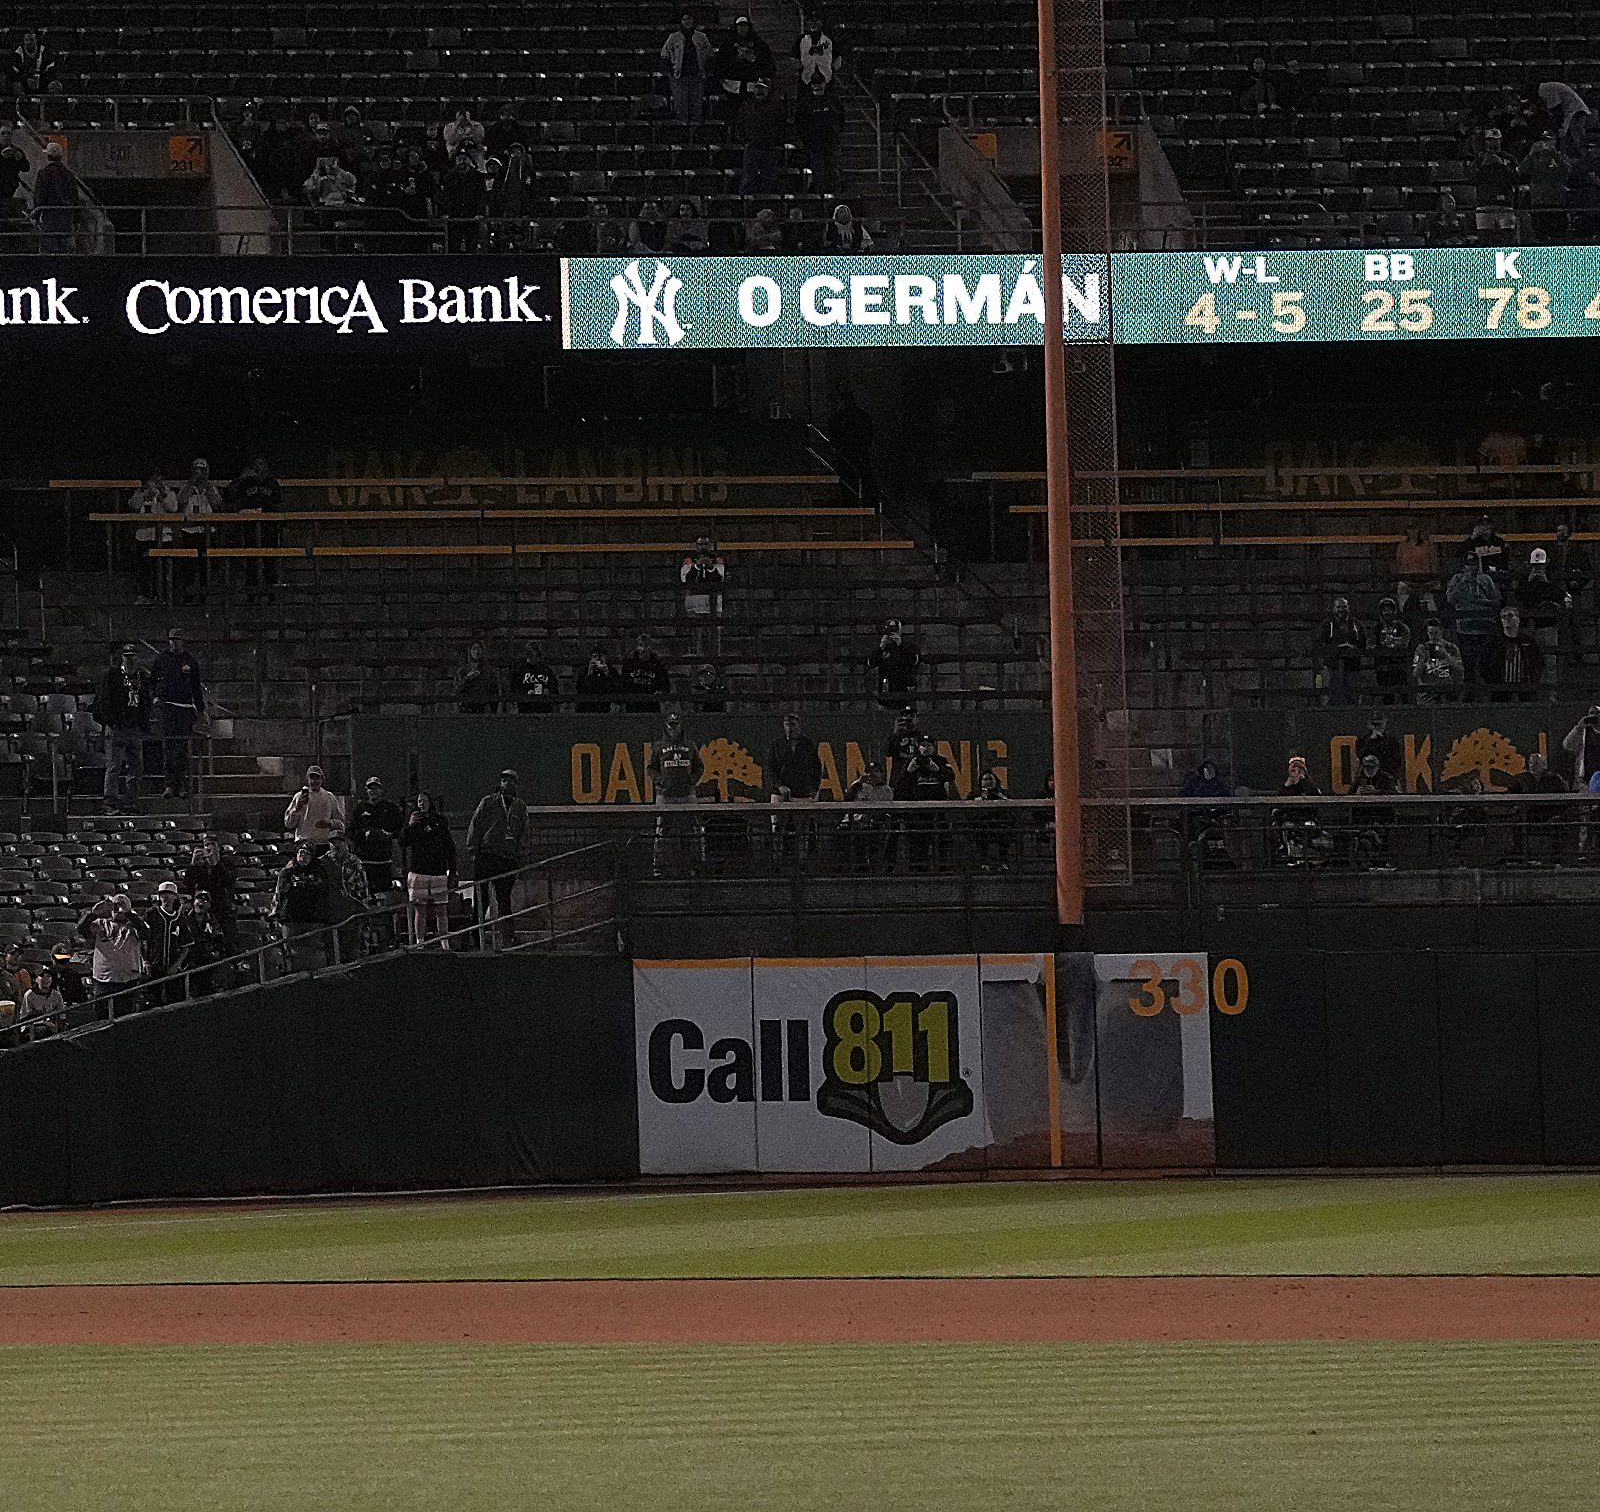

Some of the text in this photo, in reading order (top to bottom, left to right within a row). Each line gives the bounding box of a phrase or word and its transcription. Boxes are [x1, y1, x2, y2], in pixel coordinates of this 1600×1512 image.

[172, 159, 194, 172] 231
[1203, 255, 1279, 284] W-L
[1364, 253, 1415, 282] BB
[1495, 251, 1522, 280] K
[799, 259, 1102, 327] GERMÁN
[1361, 290, 1435, 333] 25
[1478, 286, 1552, 331] 78
[1127, 958, 1250, 1017] 330
[648, 999, 951, 1105] Call 811
